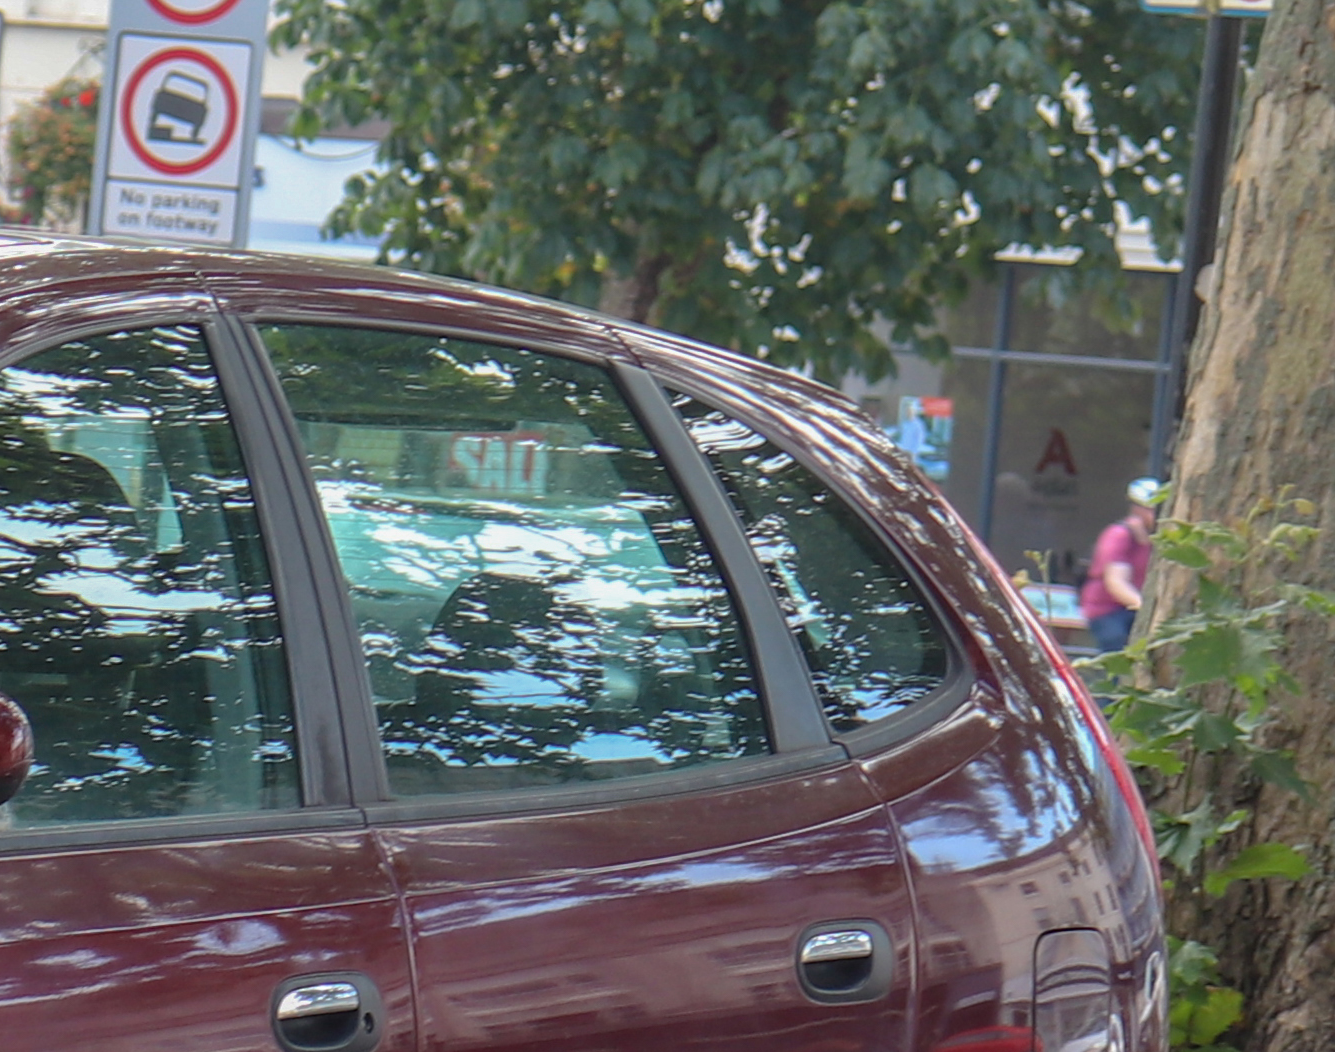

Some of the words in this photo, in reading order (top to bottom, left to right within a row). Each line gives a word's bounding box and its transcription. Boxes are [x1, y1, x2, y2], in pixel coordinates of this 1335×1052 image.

[120, 187, 146, 204] No
[151, 192, 220, 214] parking
[117, 211, 140, 225] on
[146, 210, 218, 235] footway
[1034, 427, 1078, 476] A
